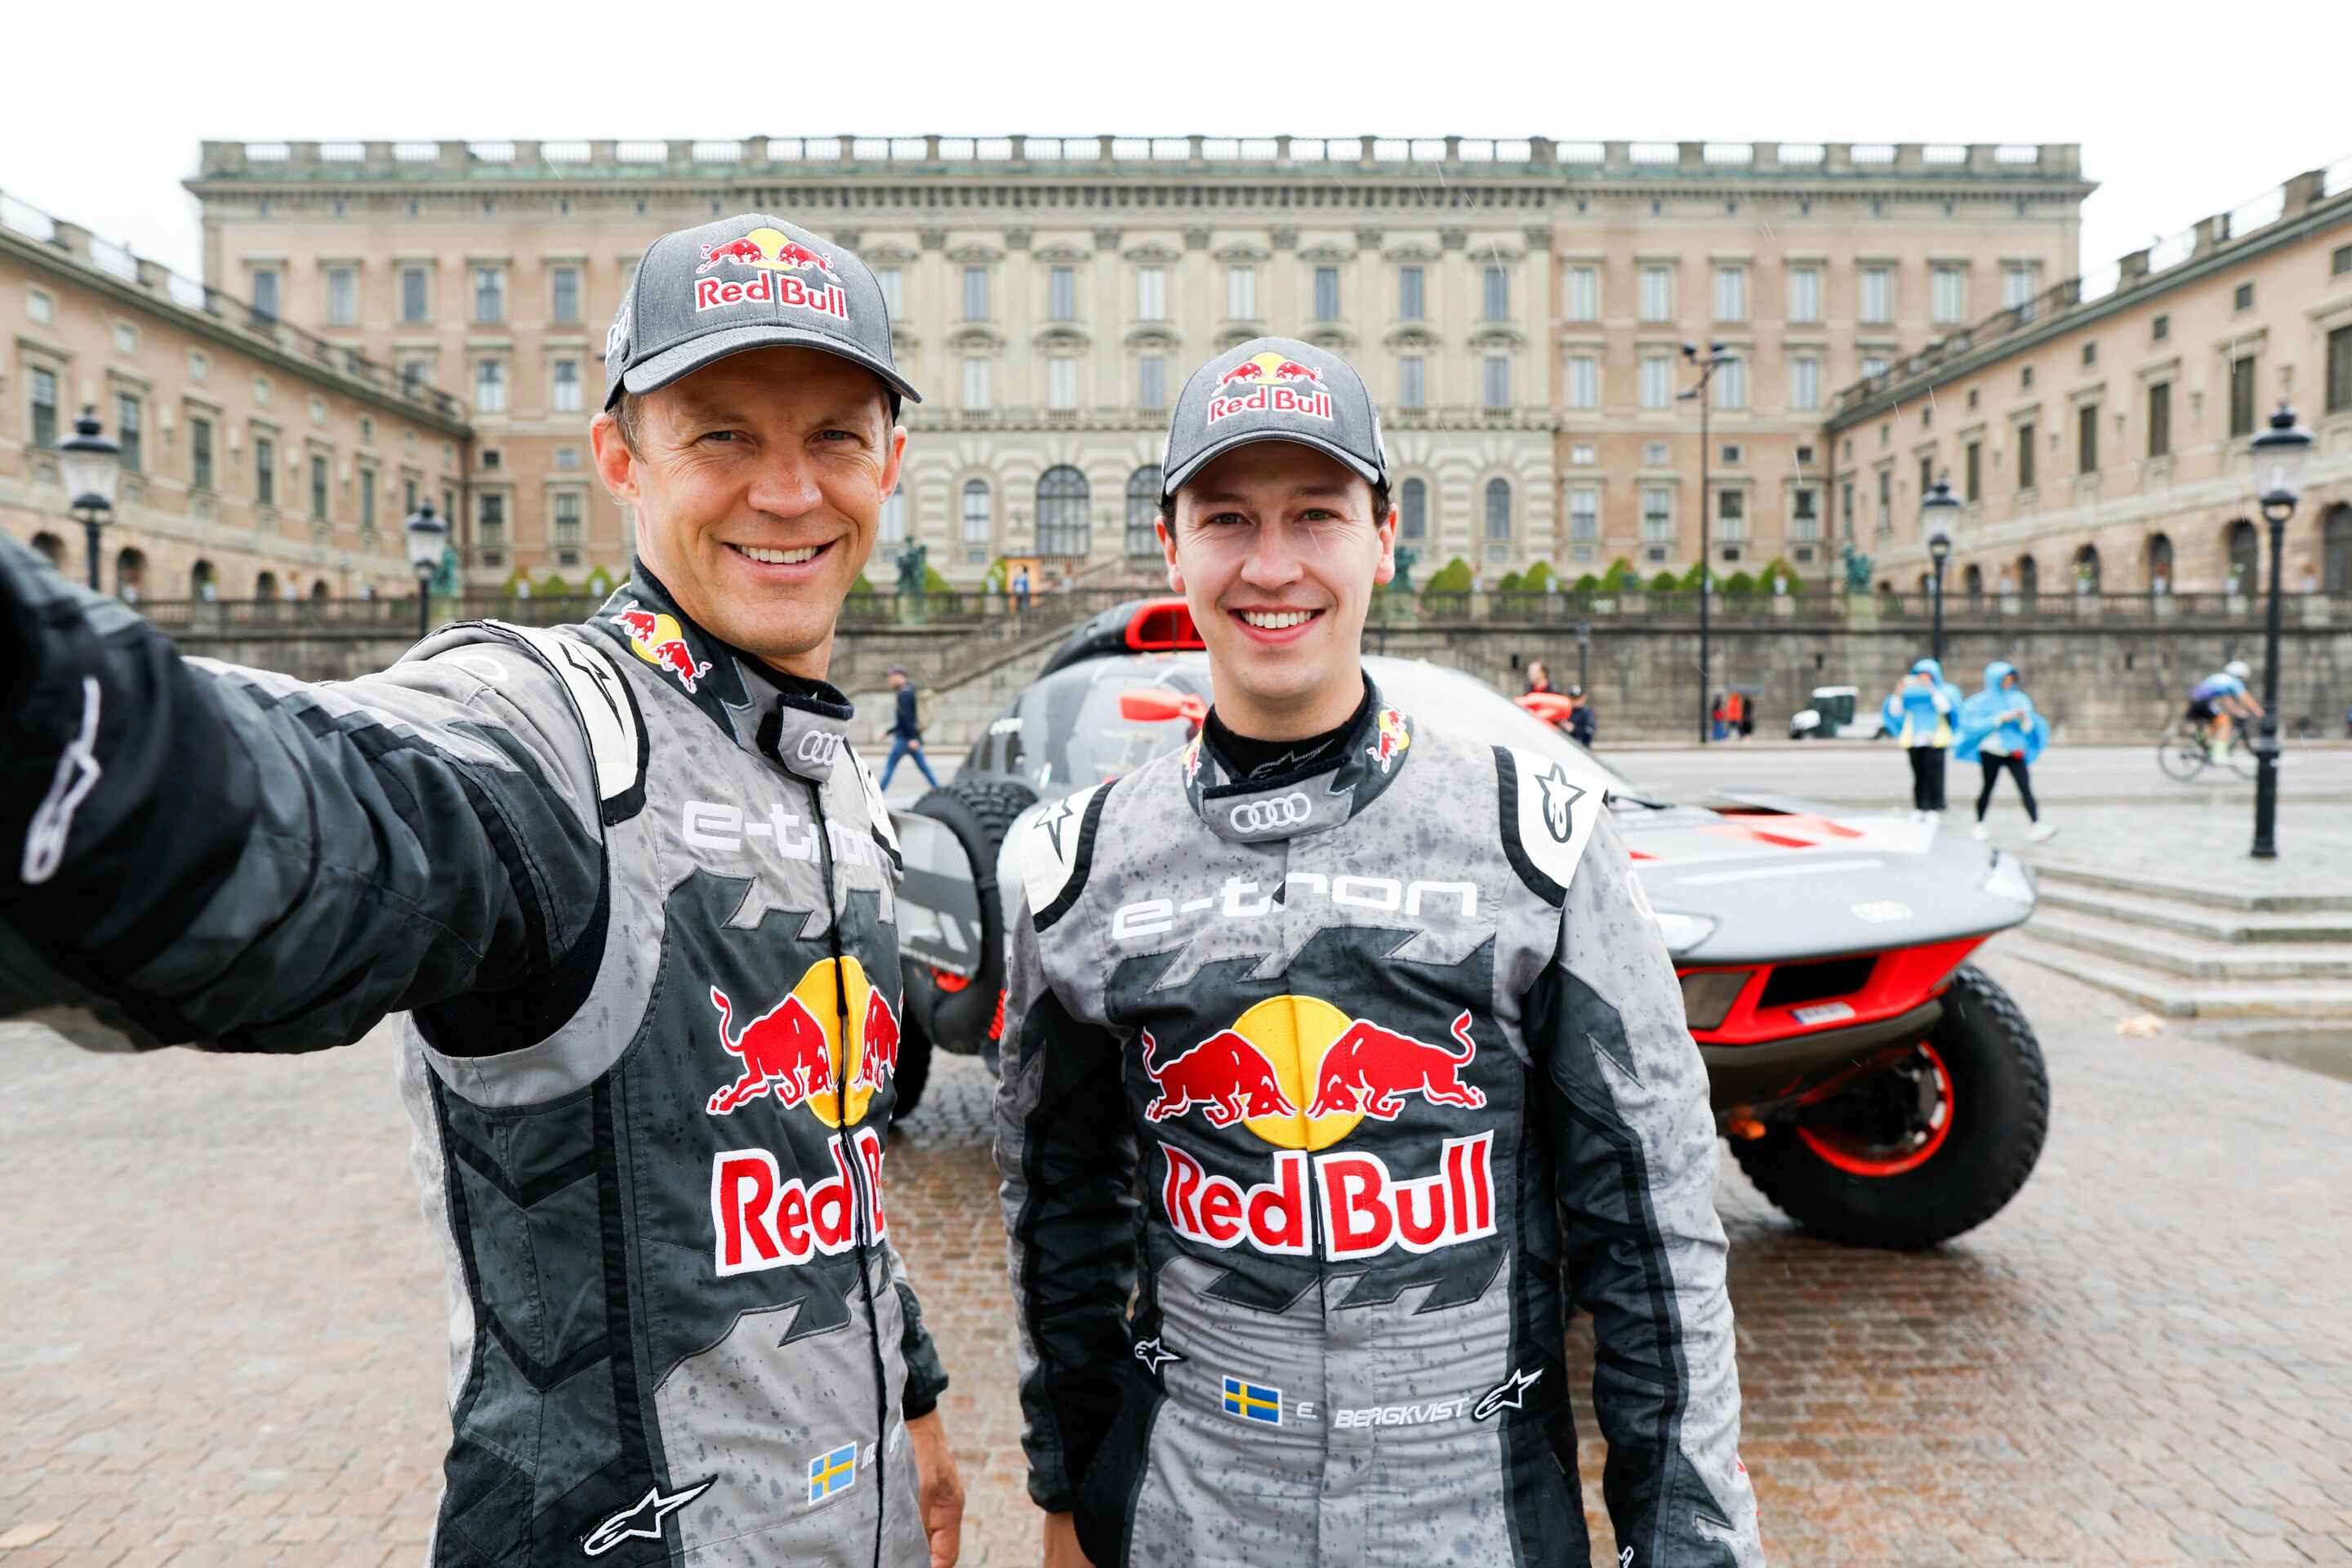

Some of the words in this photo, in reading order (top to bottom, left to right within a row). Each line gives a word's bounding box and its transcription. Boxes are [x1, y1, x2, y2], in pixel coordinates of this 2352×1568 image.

[697, 271, 772, 311] Red
[779, 276, 846, 319] Bull
[1209, 386, 1267, 424] Red
[1274, 388, 1331, 420] Bull
[1111, 872, 1477, 939] e-tron
[718, 1142, 853, 1267] Red
[1162, 1145, 1305, 1250] Red
[1321, 1138, 1491, 1255] Bull
[1296, 1402, 1317, 1420] E.
[1334, 1397, 1470, 1428] BERGKVIST
